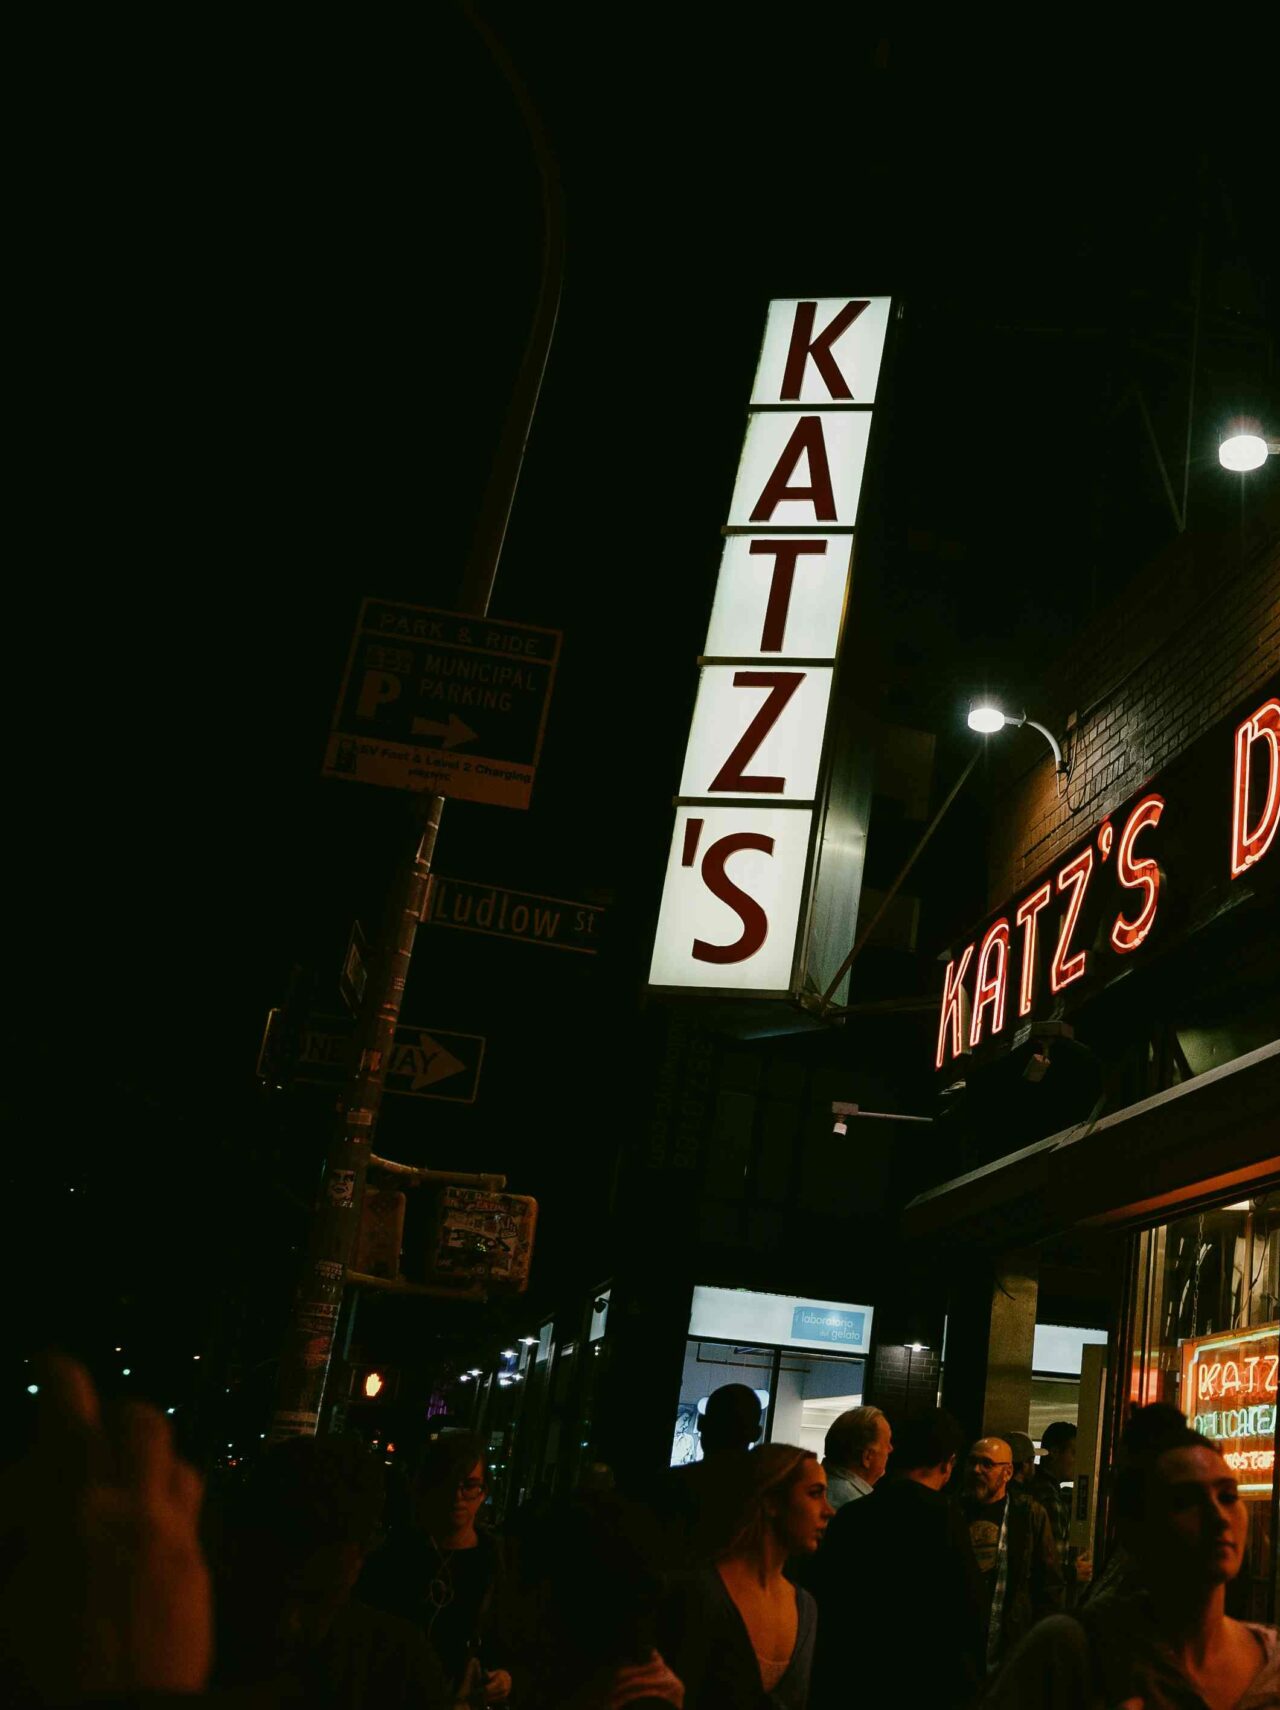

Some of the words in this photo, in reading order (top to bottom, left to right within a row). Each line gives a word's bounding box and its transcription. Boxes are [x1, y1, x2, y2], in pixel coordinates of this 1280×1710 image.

[379, 613, 445, 639] PARK
[456, 625, 474, 645] &
[485, 630, 541, 656] RIDE
[680, 300, 872, 965] KATZ'S
[355, 669, 401, 720] P
[419, 677, 513, 713] PARKING
[424, 653, 538, 692] MUNICIPAL
[434, 882, 561, 939] Ludlow
[935, 793, 1166, 1072] KATZ'S
[831, 1327, 861, 1341] gelato
[1198, 1355, 1280, 1400] KATZ
